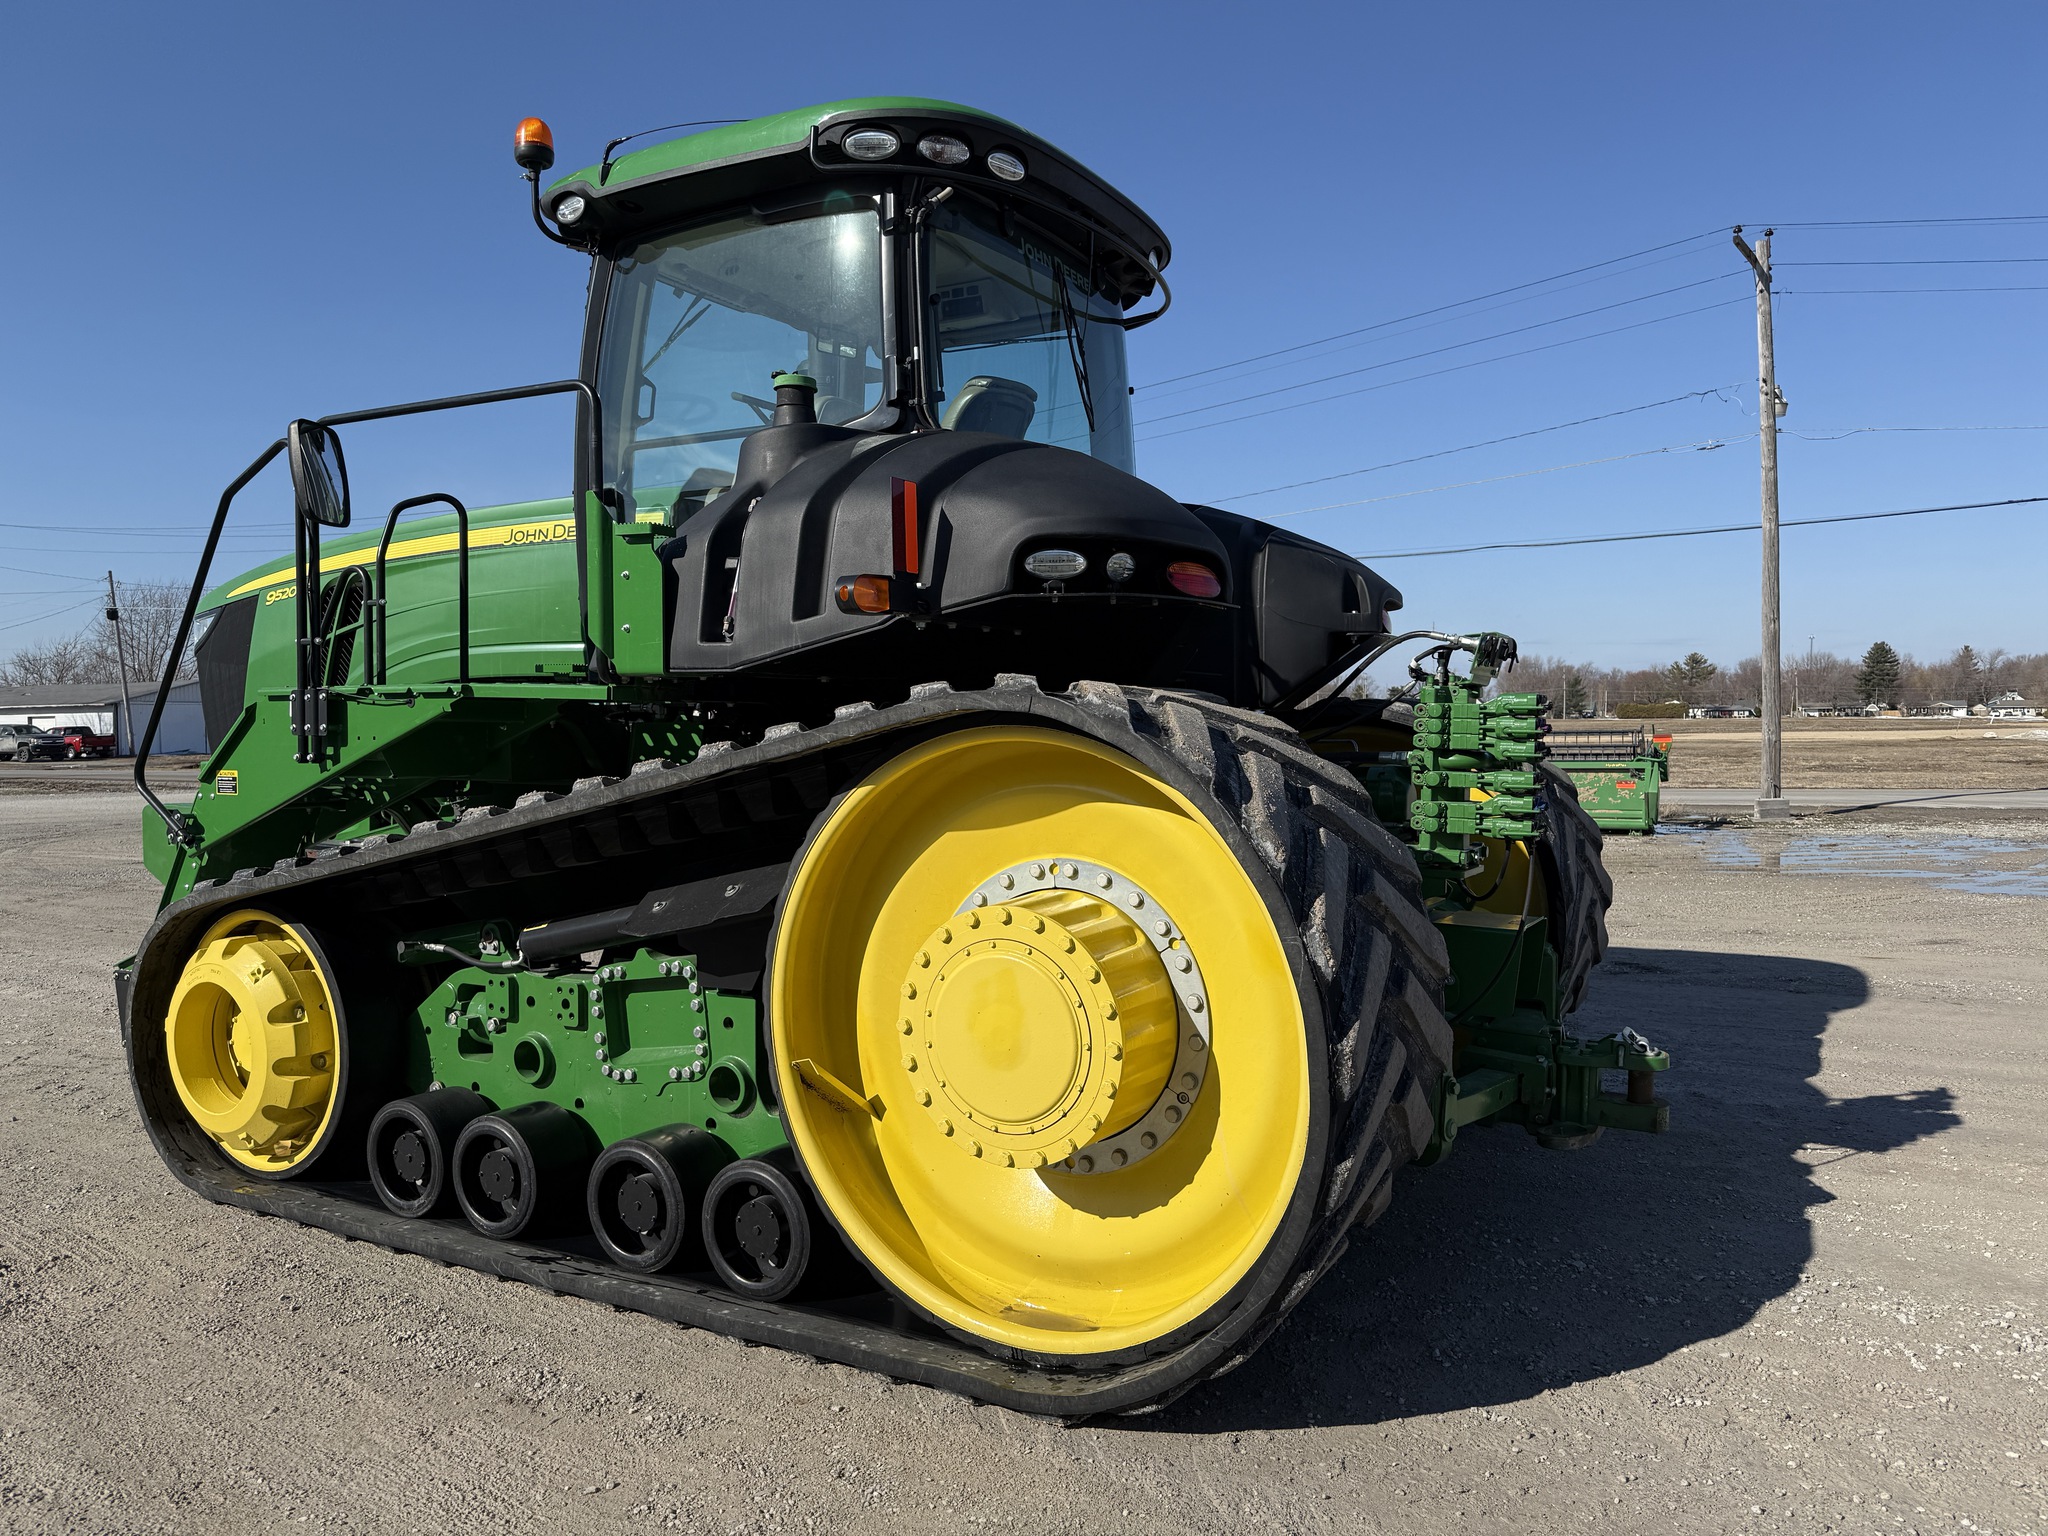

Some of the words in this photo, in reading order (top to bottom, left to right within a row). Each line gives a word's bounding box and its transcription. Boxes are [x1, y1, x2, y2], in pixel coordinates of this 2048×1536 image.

[1017, 236, 1054, 270] JOHN
[1054, 255, 1089, 291] DEERE
[503, 528, 549, 543] JOHN
[265, 585, 296, 606] 9520
